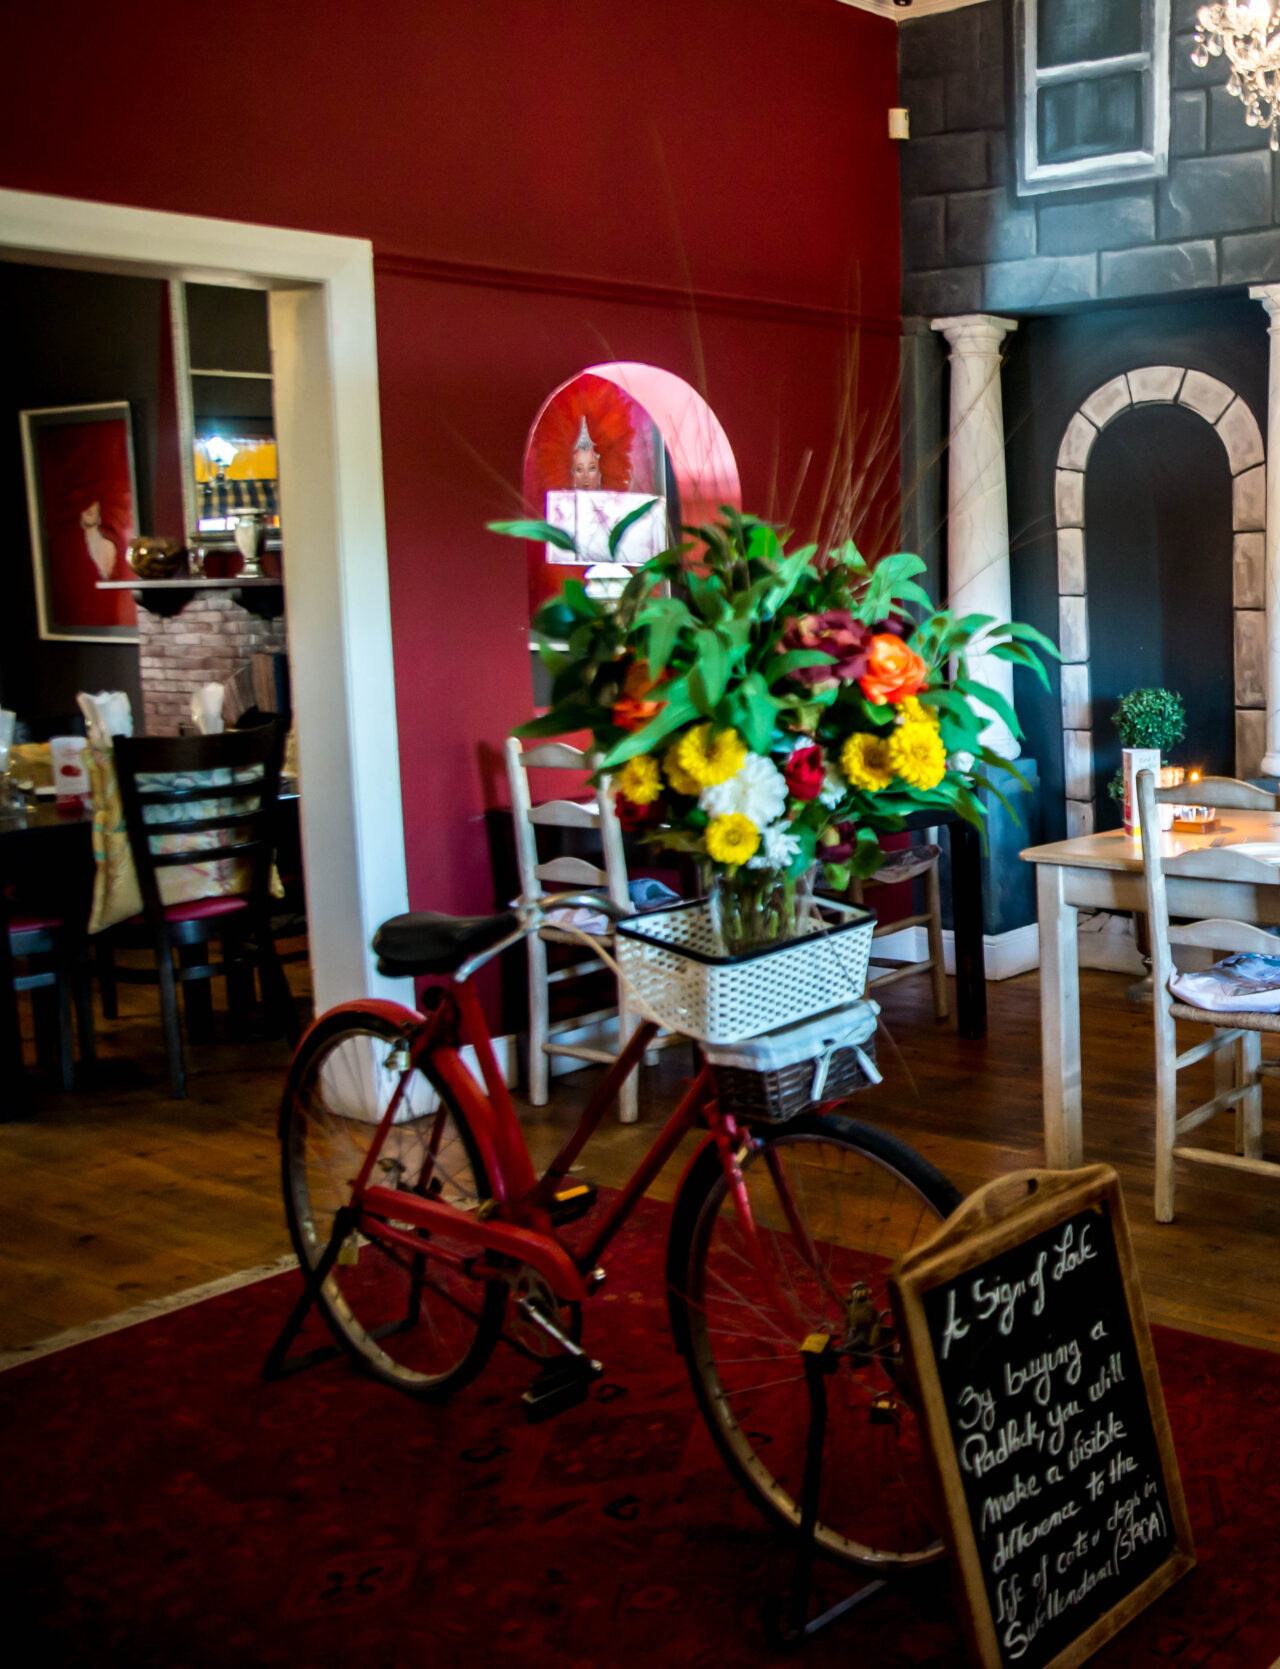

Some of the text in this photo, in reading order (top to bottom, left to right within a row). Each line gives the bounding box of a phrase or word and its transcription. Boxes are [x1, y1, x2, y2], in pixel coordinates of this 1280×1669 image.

[973, 1275, 1026, 1335] Sign
[1029, 1251, 1047, 1316] of
[1052, 1223, 1098, 1281] Love
[959, 1320, 1109, 1431] By buying a
[1047, 1400, 1084, 1456] you
[1088, 1351, 1126, 1401] will
[992, 1451, 1140, 1574] difference to the
[1046, 1465, 1065, 1485] a
[1032, 1554, 1048, 1601] of
[1056, 1530, 1090, 1574] cats
[1107, 1490, 1142, 1532] dogs
[1143, 1474, 1158, 1498] in
